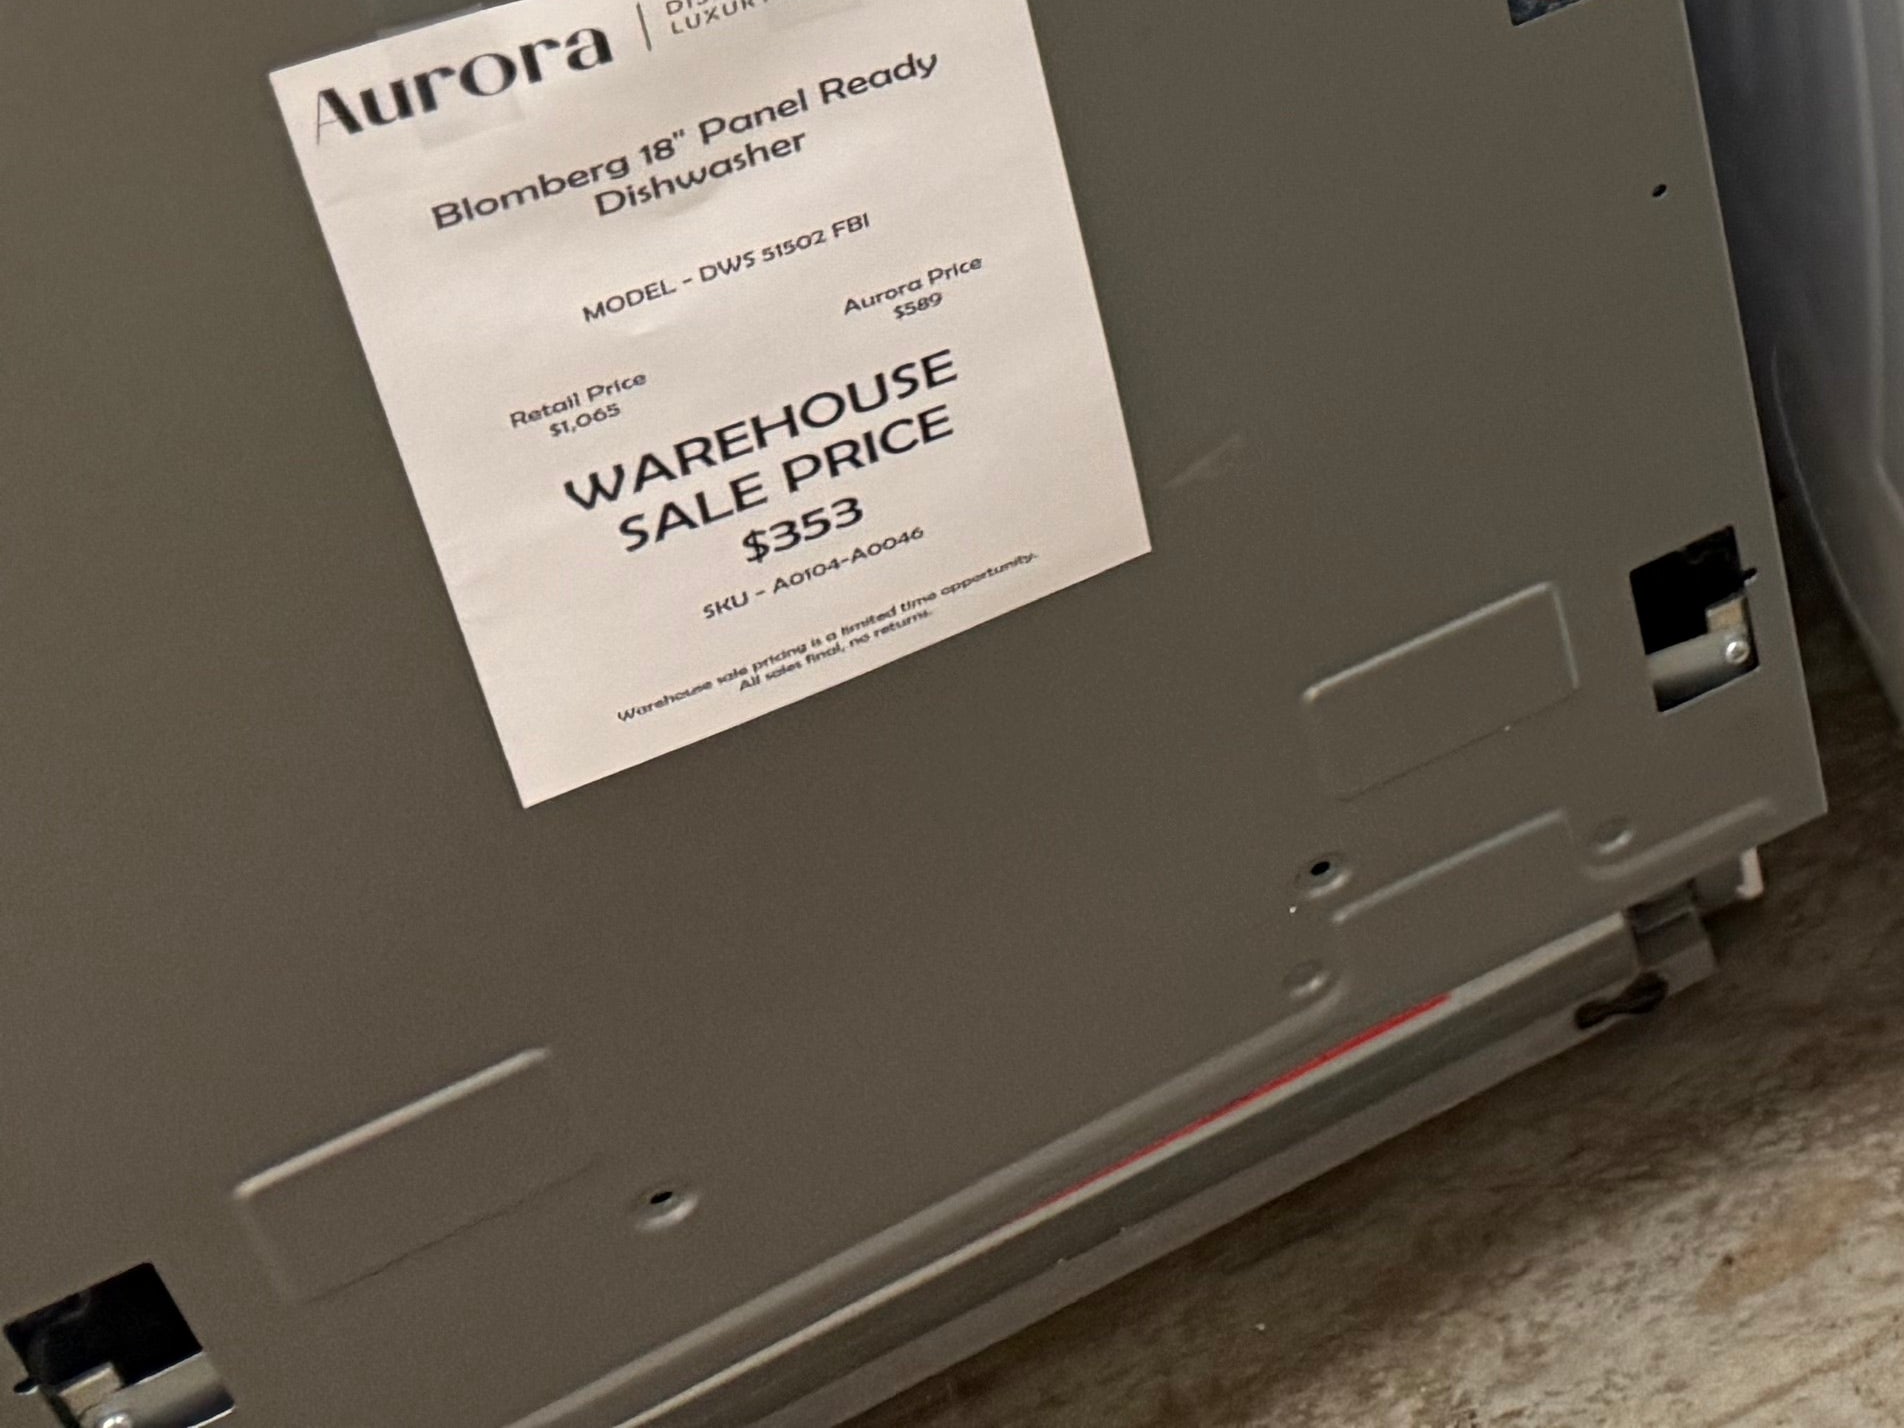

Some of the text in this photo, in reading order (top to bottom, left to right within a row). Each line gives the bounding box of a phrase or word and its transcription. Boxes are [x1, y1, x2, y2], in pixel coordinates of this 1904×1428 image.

[315, 25, 614, 147] Aurora
[430, 155, 632, 231] Blomberg
[699, 88, 809, 145] Panel
[820, 51, 939, 107] Ready
[593, 129, 807, 218] Dishwasher
[582, 278, 677, 323] MODEL
[698, 249, 756, 284] DWS
[761, 229, 828, 263] 51502
[831, 213, 870, 241] FBI
[843, 256, 983, 315] Aurora Price
[892, 292, 944, 321] $589
[508, 371, 647, 429] Retail Price
[548, 403, 622, 439] $1,065
[563, 348, 959, 512] WAREHOUSE
[617, 404, 955, 554] SALE PRICE
[702, 590, 749, 620] SKU
[773, 525, 925, 595] A0104-A0046
[740, 497, 863, 564] $353
[616, 680, 714, 724] Warehouse
[716, 664, 749, 687] sale
[751, 641, 809, 676] pricing
[840, 605, 898, 637] limited
[899, 590, 938, 615] time
[739, 673, 761, 693] All
[764, 659, 803, 681] sales
[848, 633, 871, 649] no
